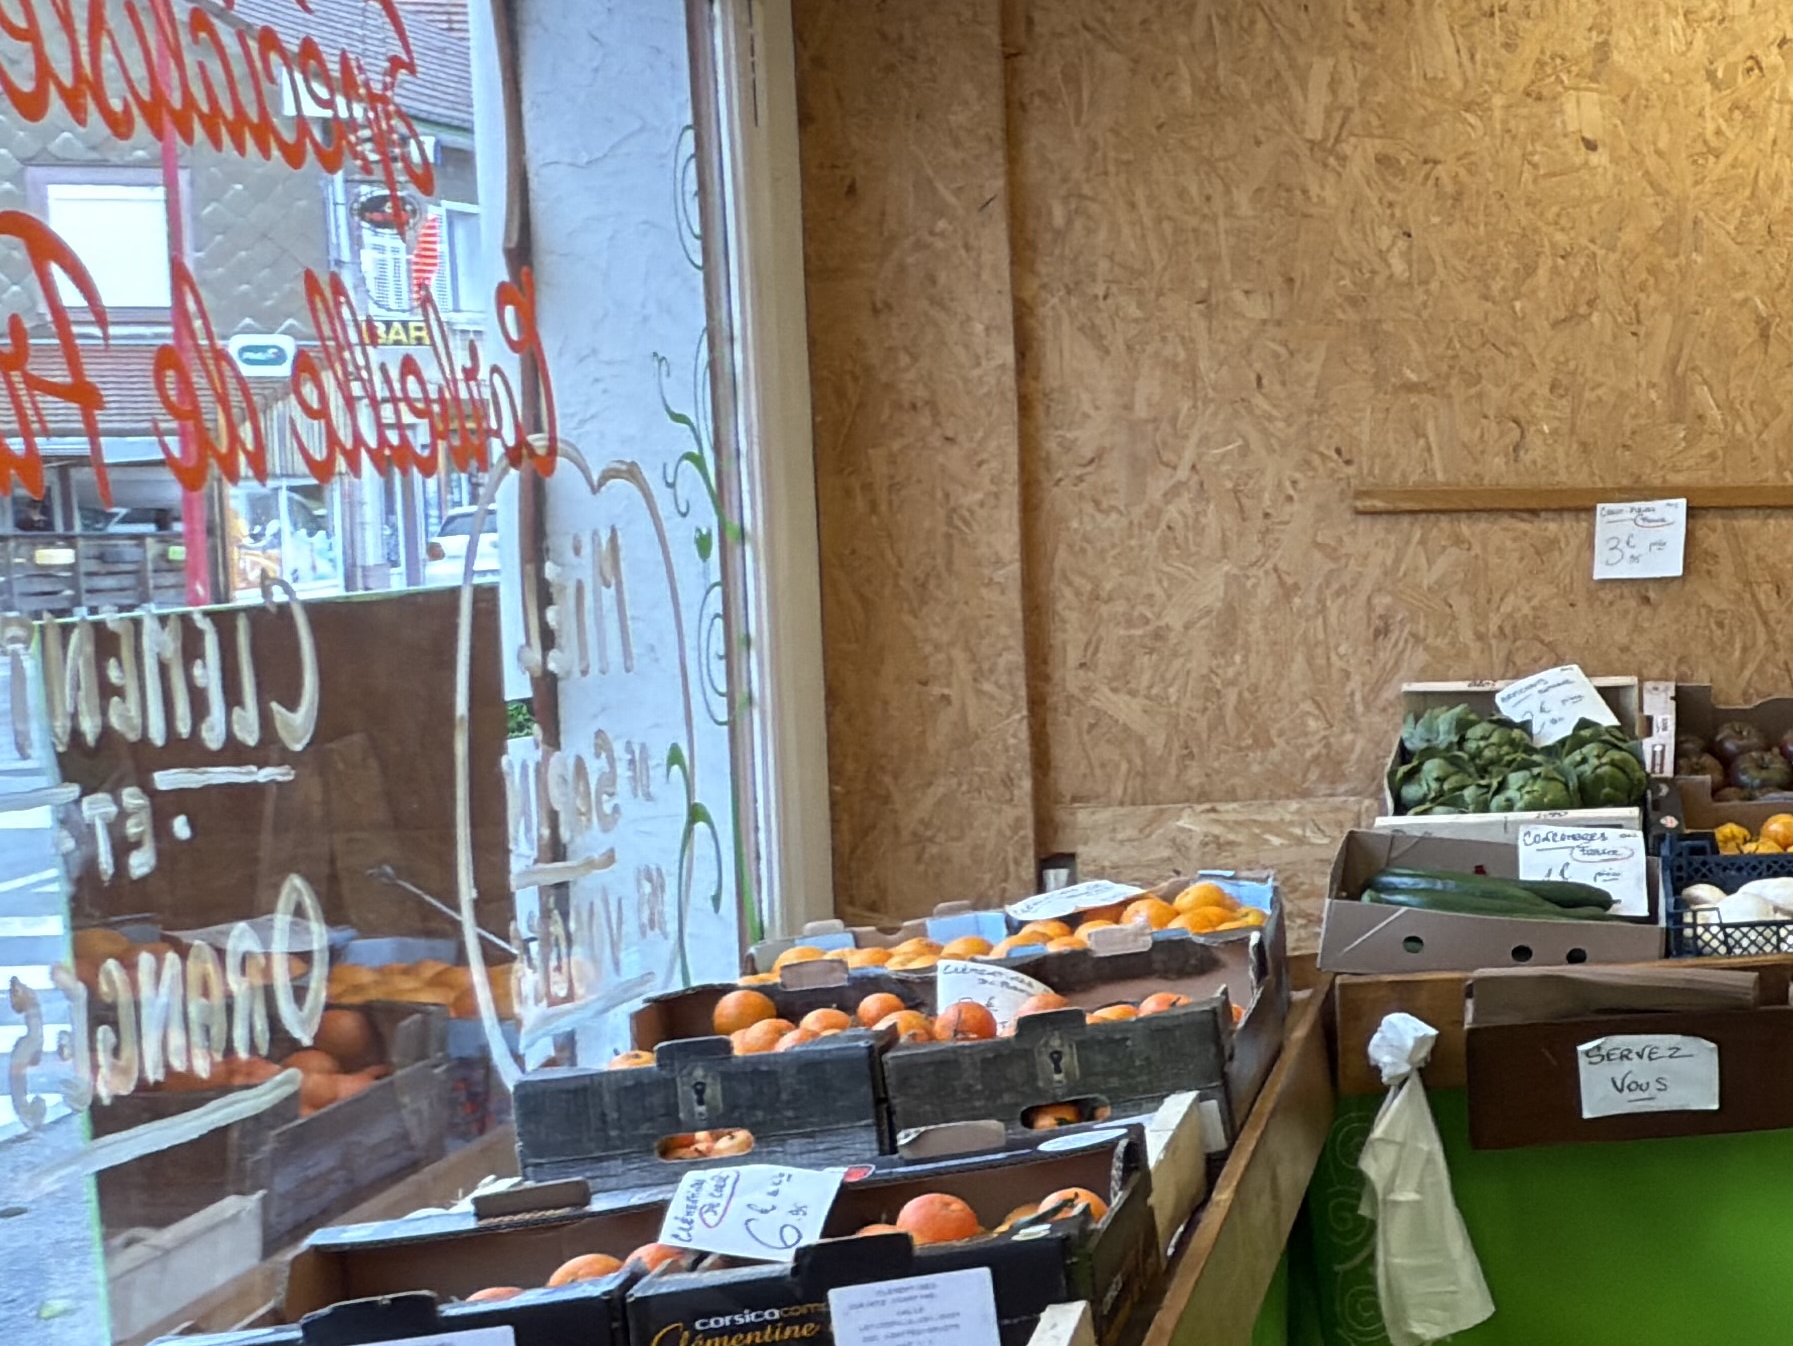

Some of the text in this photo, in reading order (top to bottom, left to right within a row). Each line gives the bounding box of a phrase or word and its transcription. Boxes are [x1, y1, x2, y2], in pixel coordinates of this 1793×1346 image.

[362, 320, 431, 346] BAR
[1585, 1045, 1694, 1065] SERVEZ
[1611, 1070, 1668, 1094] VOUS
[745, 1218, 803, 1250] 6
